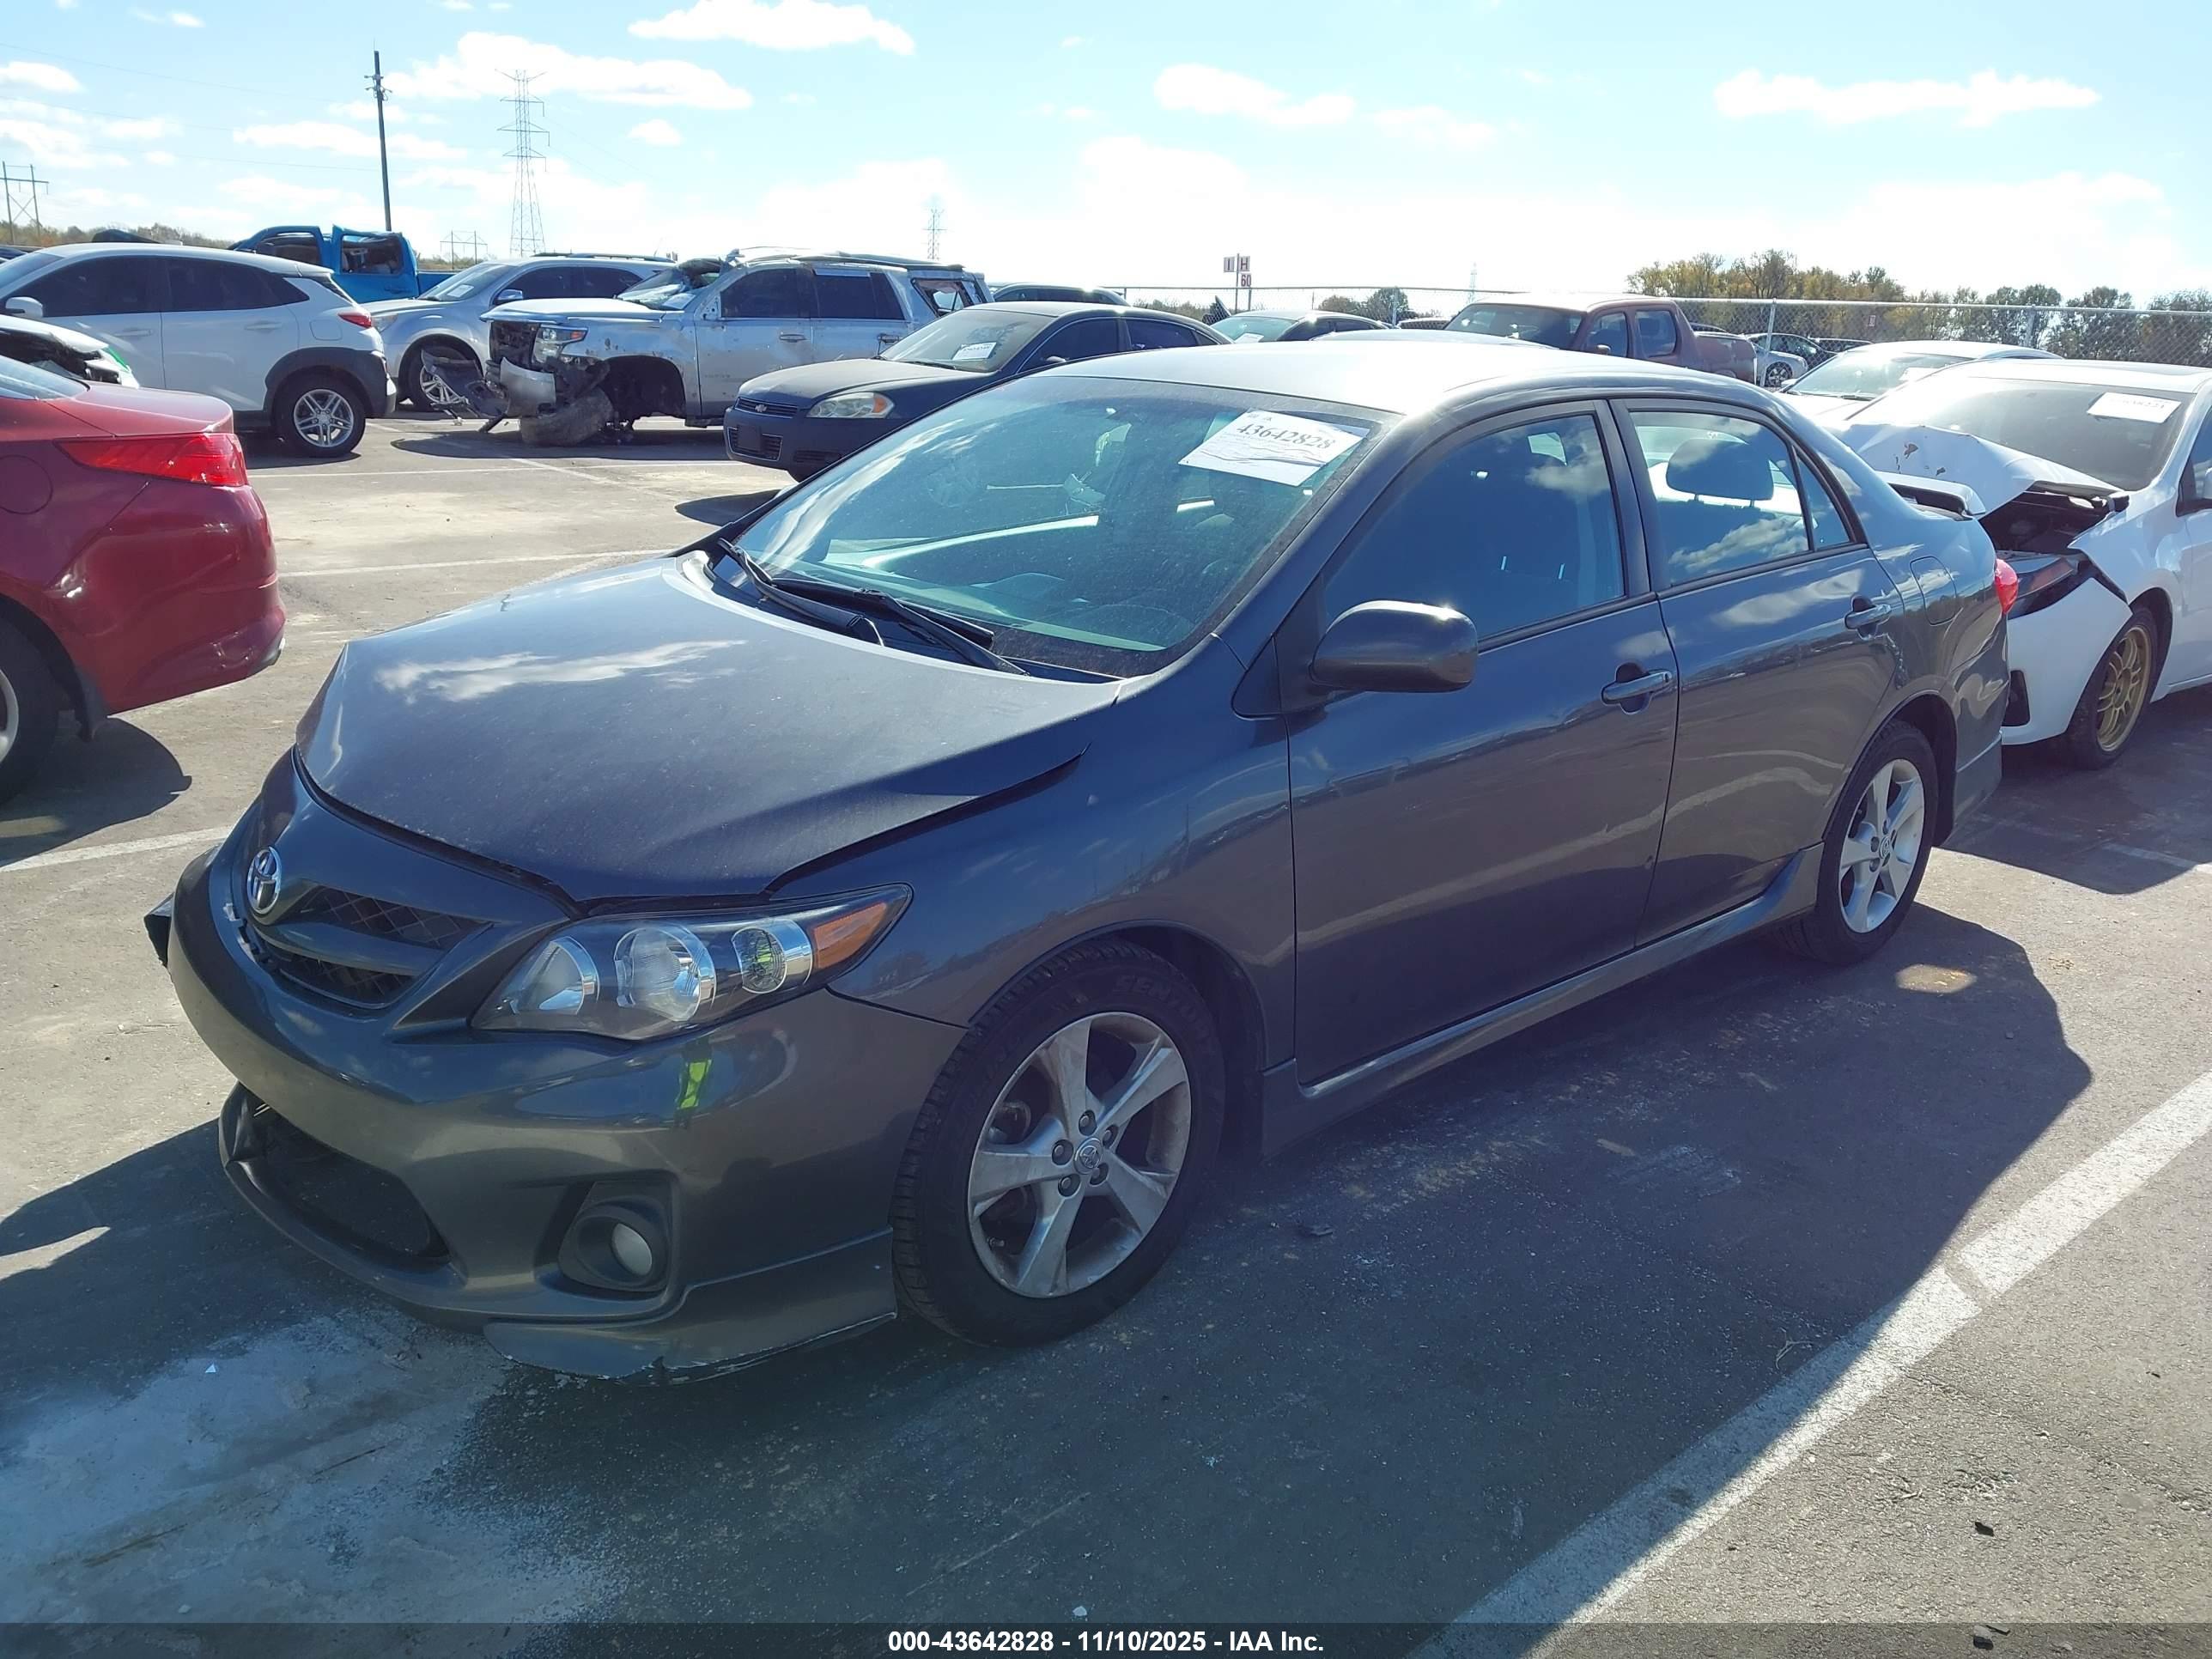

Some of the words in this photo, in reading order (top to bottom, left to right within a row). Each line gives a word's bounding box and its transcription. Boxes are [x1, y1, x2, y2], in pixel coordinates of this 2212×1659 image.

[1241, 257, 1248, 270] H
[1241, 274, 1251, 287] 60
[1237, 423, 1336, 449] 43642828
